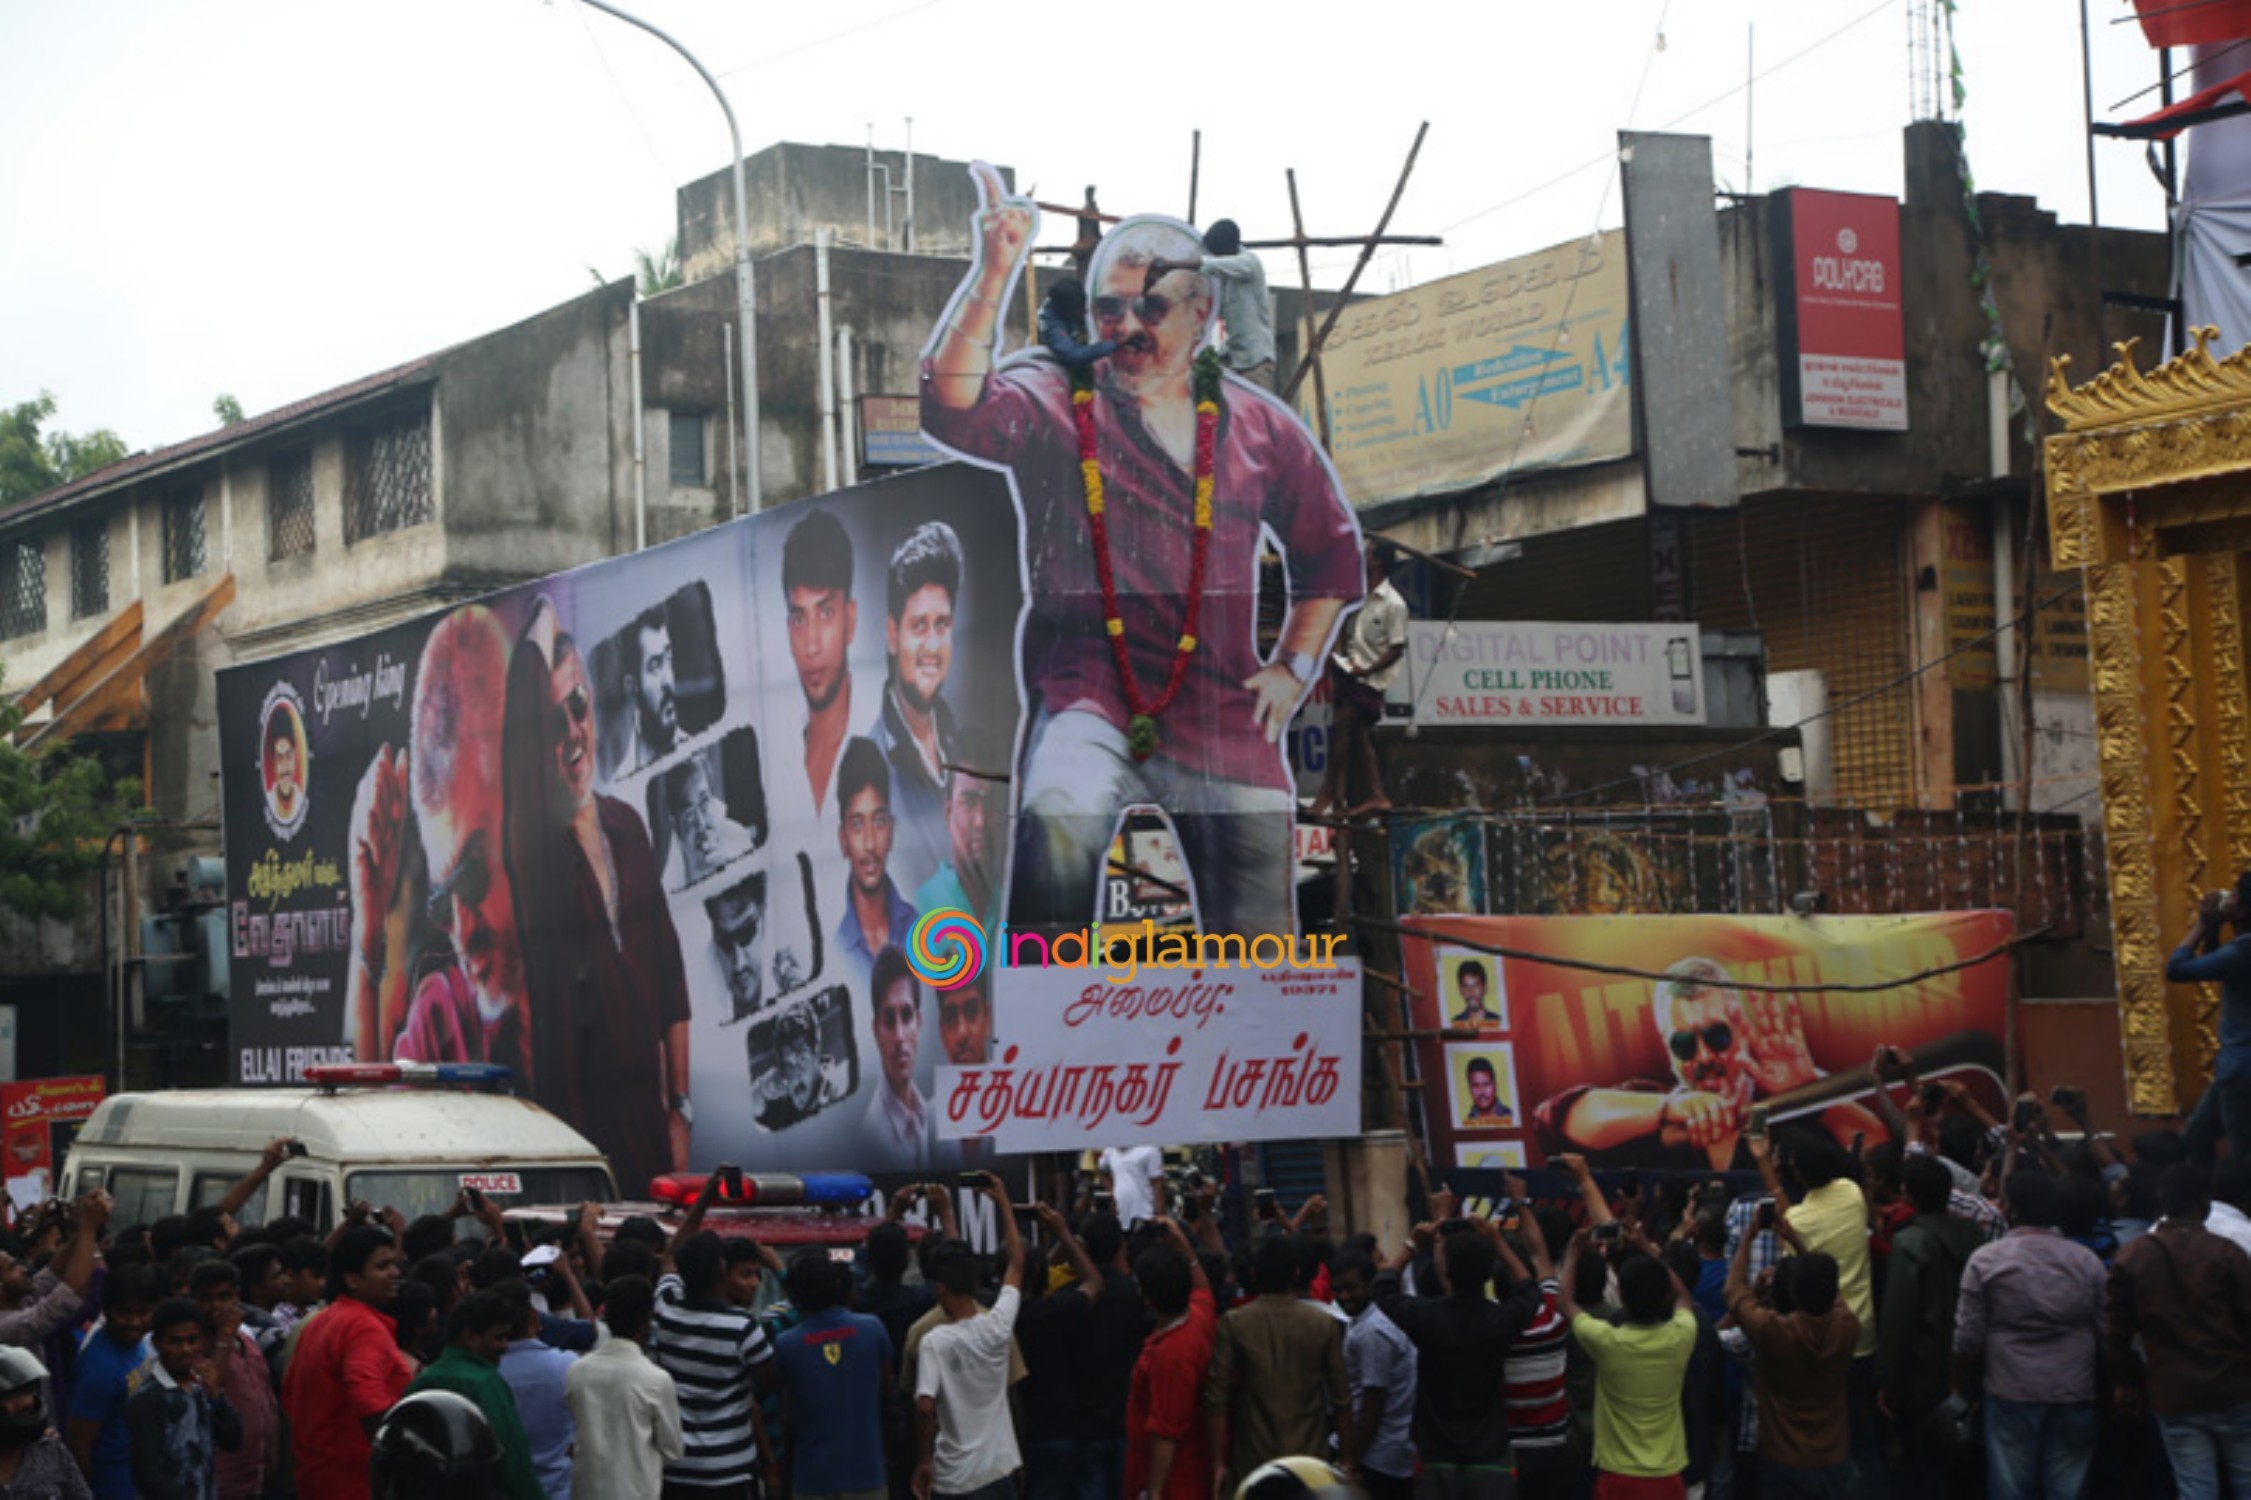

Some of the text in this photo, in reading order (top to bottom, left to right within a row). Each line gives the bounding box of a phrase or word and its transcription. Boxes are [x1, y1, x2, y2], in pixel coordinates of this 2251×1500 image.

[1812, 255, 1886, 293] POLYCAB
[1454, 302, 1546, 342] WORLD
[1416, 632, 1650, 663] DIGITAL POINT
[314, 657, 372, 726] Opening
[1464, 669, 1615, 690] CELL PHONE
[1436, 696, 1644, 718] SALES & SERVICE
[241, 1047, 282, 1082] ELLAI
[947, 1031, 1341, 1134] சத்யாநகர் பசங்க
